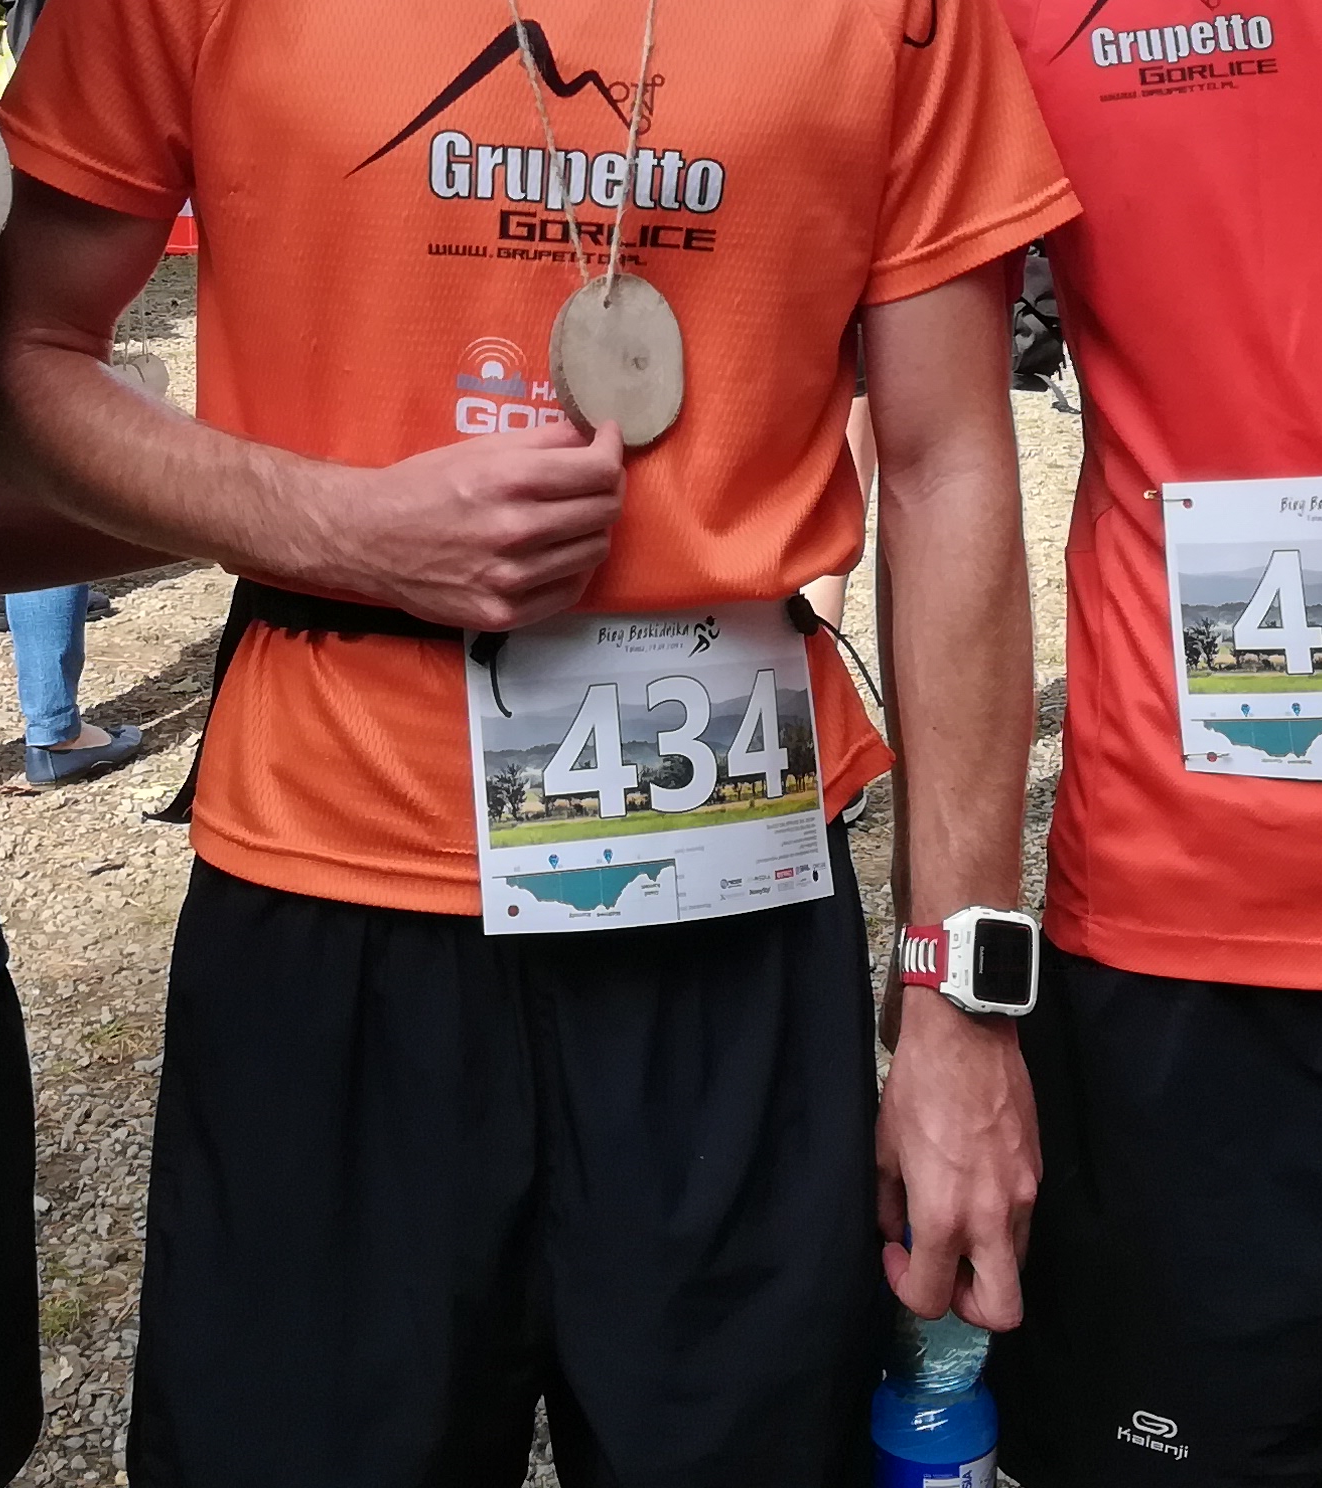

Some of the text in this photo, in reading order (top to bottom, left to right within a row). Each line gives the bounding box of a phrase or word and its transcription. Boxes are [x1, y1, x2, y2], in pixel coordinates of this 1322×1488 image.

[1090, 14, 1274, 67] Grupetto
[1139, 59, 1278, 86] GORLICE
[428, 129, 726, 214] Grupetto
[499, 209, 717, 252] GORLICE
[542, 668, 789, 819] 434
[1117, 1426, 1189, 1461] Kalenji
